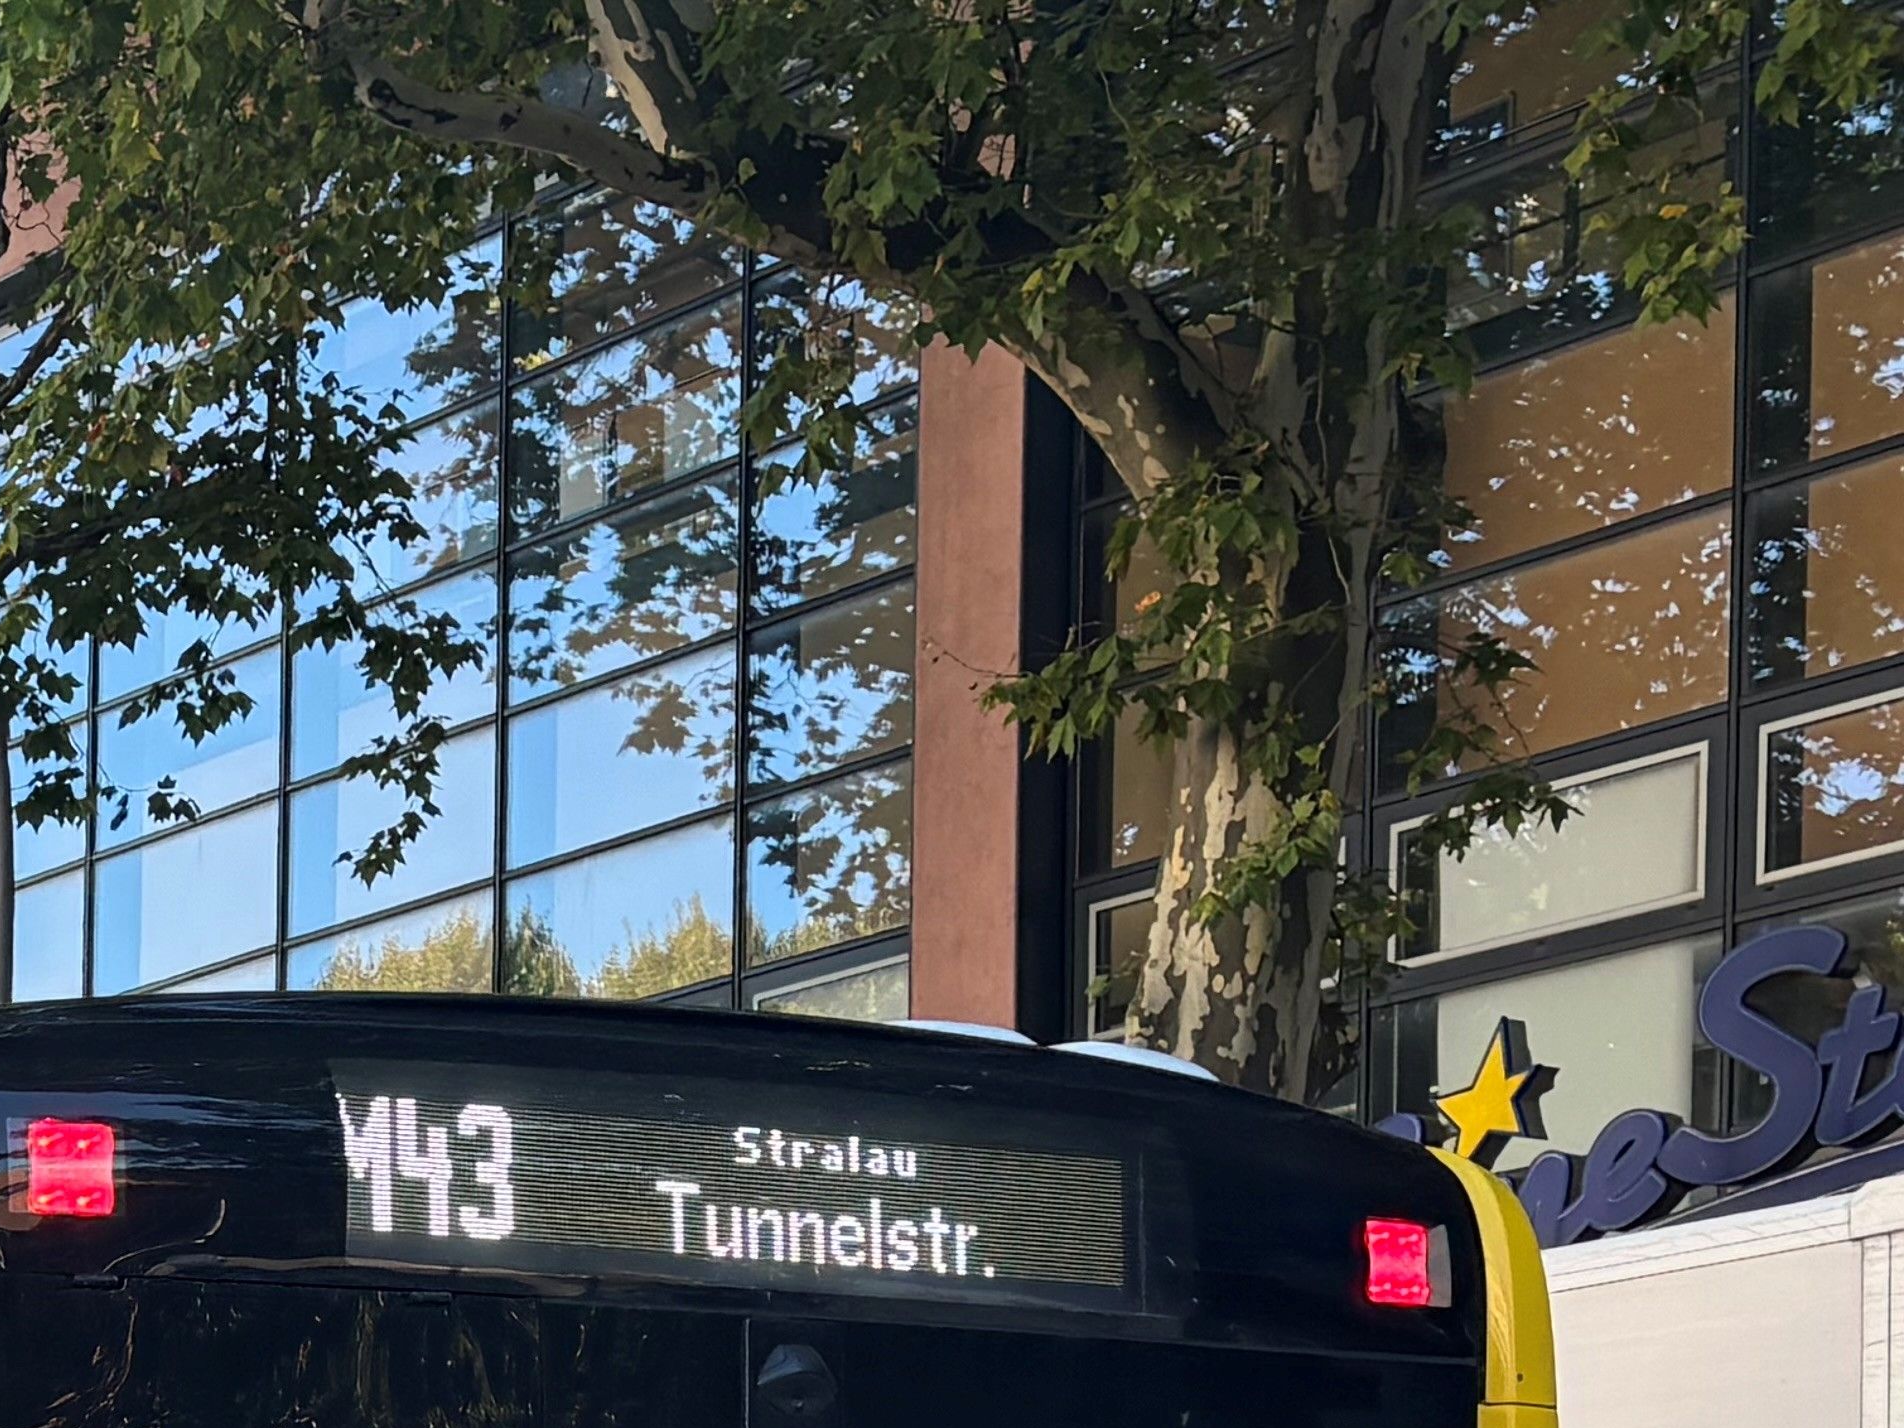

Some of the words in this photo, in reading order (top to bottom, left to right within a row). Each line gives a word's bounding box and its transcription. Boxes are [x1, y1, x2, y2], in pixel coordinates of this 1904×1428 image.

[335, 1095, 516, 1240] M43
[732, 1126, 919, 1178] Stralau
[655, 1179, 996, 1279] Tunnelstr.
